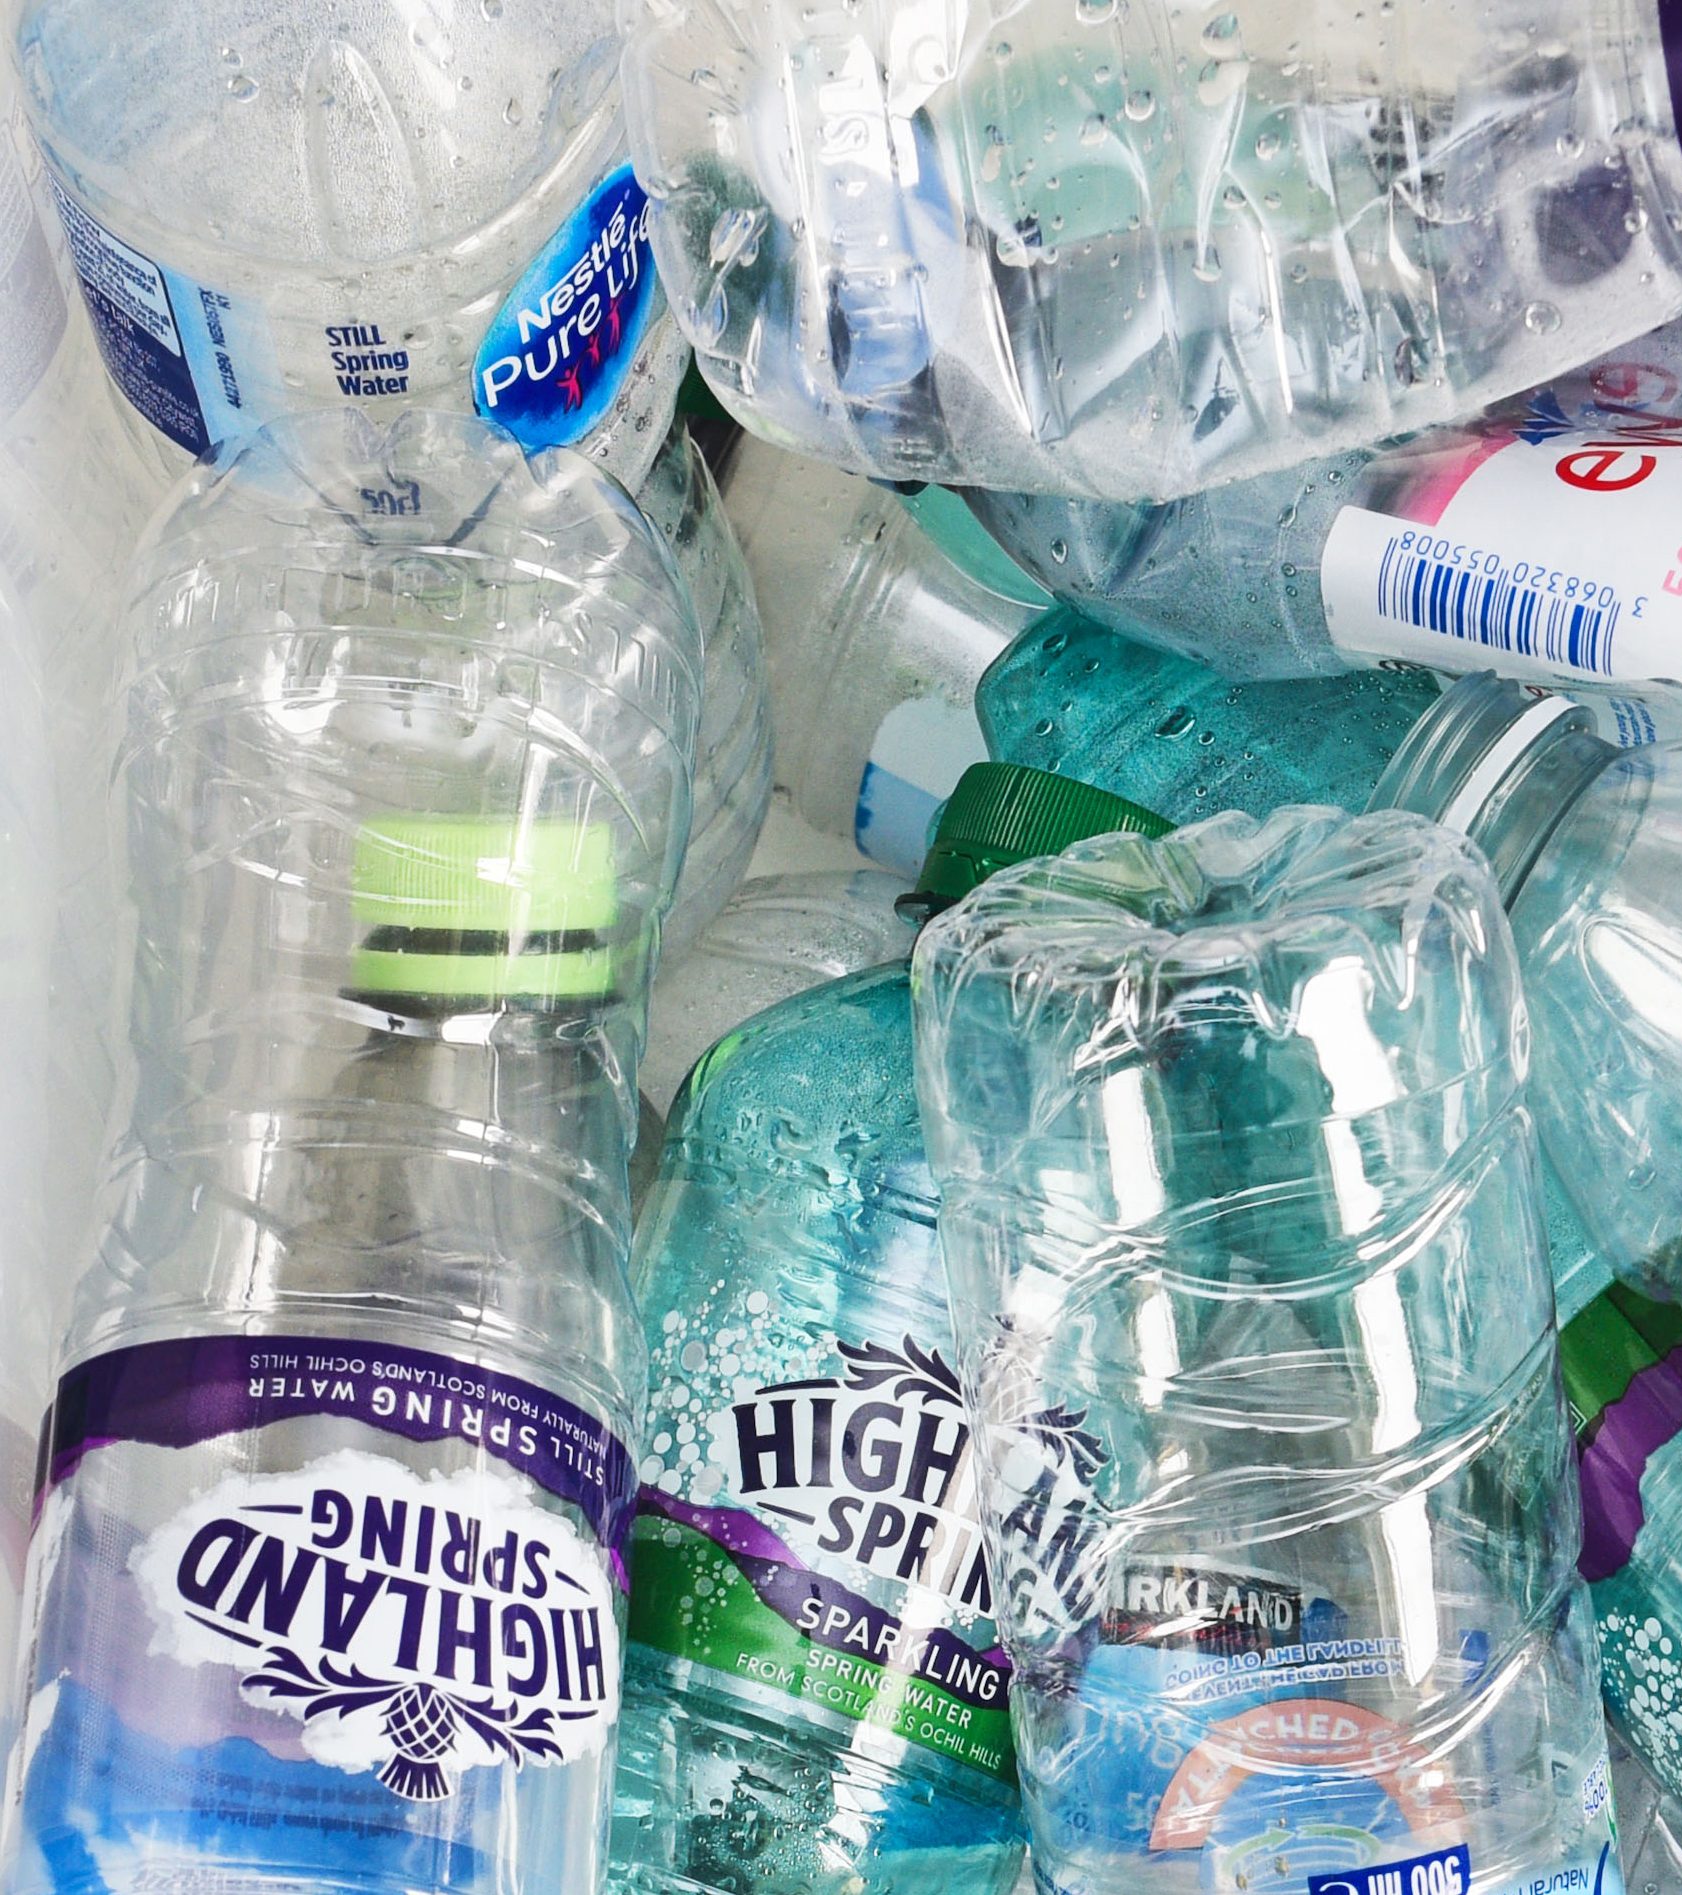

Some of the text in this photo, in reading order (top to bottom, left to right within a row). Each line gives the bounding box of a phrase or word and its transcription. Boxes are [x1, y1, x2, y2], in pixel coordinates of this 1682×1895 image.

[516, 200, 625, 346] Nestlé
[324, 324, 388, 348] STILL
[331, 350, 410, 378] Spring
[336, 375, 410, 397] Water
[481, 292, 603, 409] Pure
[1399, 529, 1502, 577] 055008
[1512, 560, 1616, 609] 068320
[248, 1353, 609, 1460] NATURALLY FROM SCOTLAND'S OCHIL HILLS
[248, 1377, 606, 1487] STILL SPRING WATER
[310, 1488, 552, 1600] SPRING
[175, 1516, 606, 1702] HIGHLAND
[796, 1596, 1000, 1702] SPARKLING
[1128, 1573, 1296, 1633] RKLAND
[735, 1651, 1003, 1772] FROM SCOTLAND'S OCHIL HILLS
[805, 1648, 974, 1731] SPRING WATER
